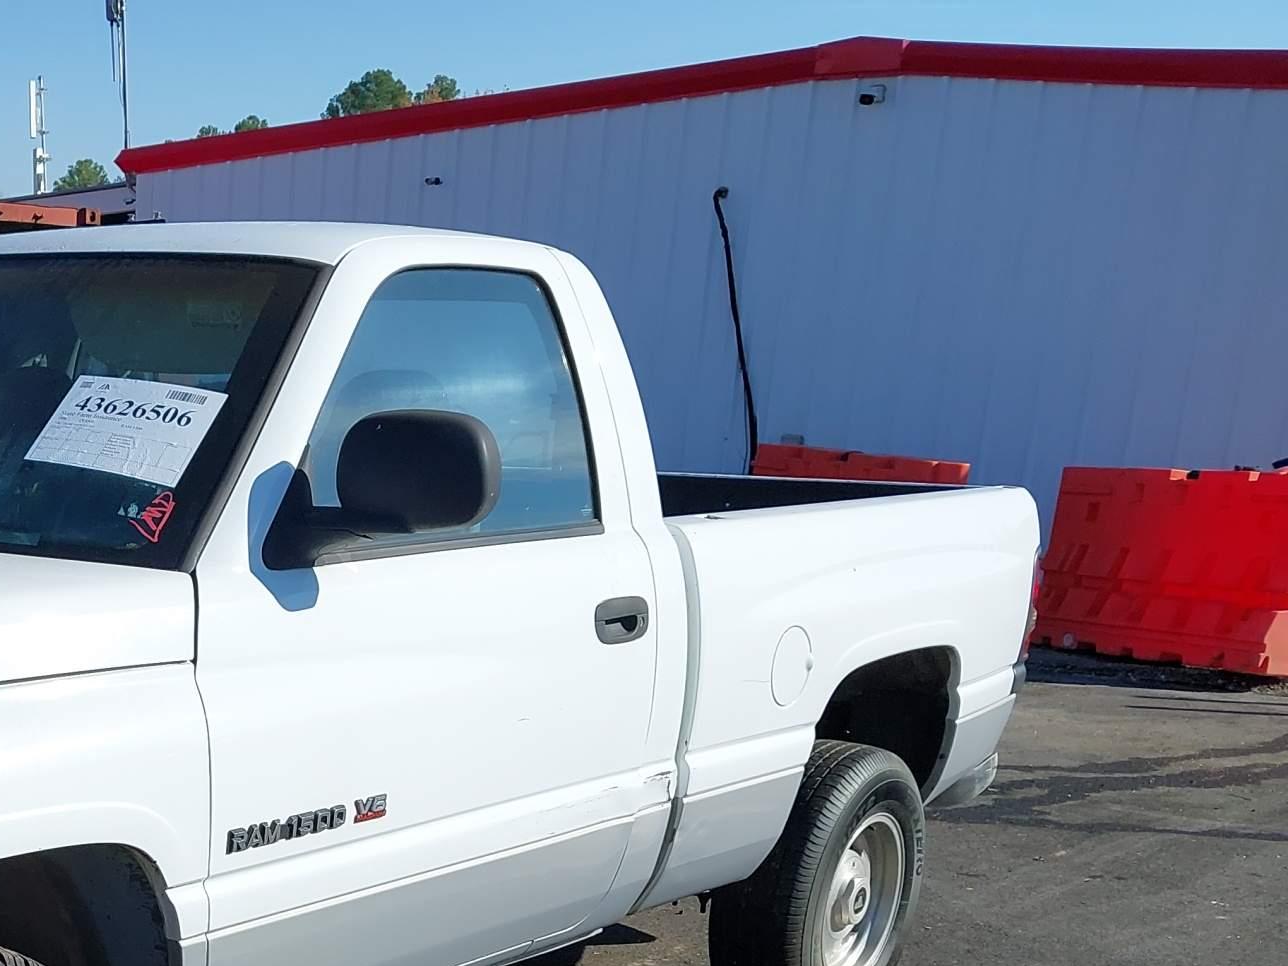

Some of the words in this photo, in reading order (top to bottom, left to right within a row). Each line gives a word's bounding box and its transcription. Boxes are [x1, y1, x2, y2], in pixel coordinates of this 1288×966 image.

[74, 395, 198, 427] 43626506
[226, 818, 281, 856] RAM
[284, 804, 347, 841] 1500
